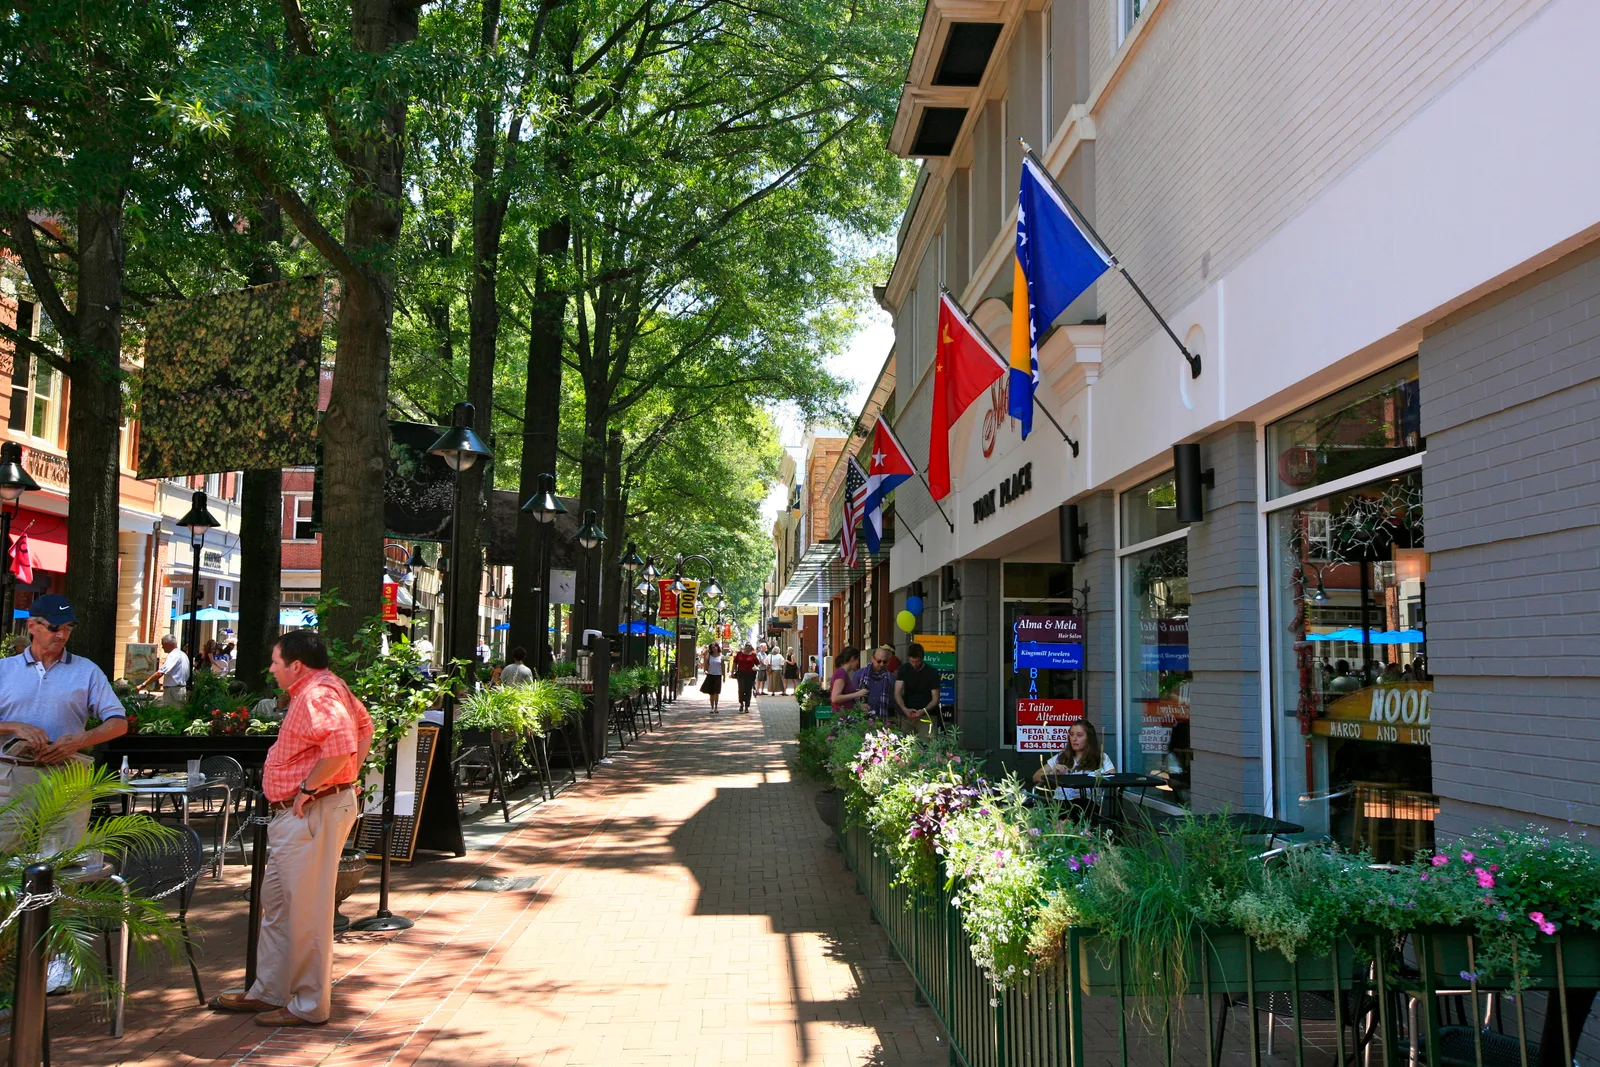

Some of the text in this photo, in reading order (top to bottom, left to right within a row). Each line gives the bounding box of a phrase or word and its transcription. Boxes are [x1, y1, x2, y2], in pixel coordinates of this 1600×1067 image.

[999, 461, 1033, 508] PLACE
[385, 586, 392, 595] 3
[1018, 619, 1077, 630] Alma & Mela
[1018, 702, 1054, 712] E. Tailor
[1036, 712, 1083, 722] Alterations
[1330, 721, 1361, 738] MARCO
[1376, 726, 1398, 742] AND
